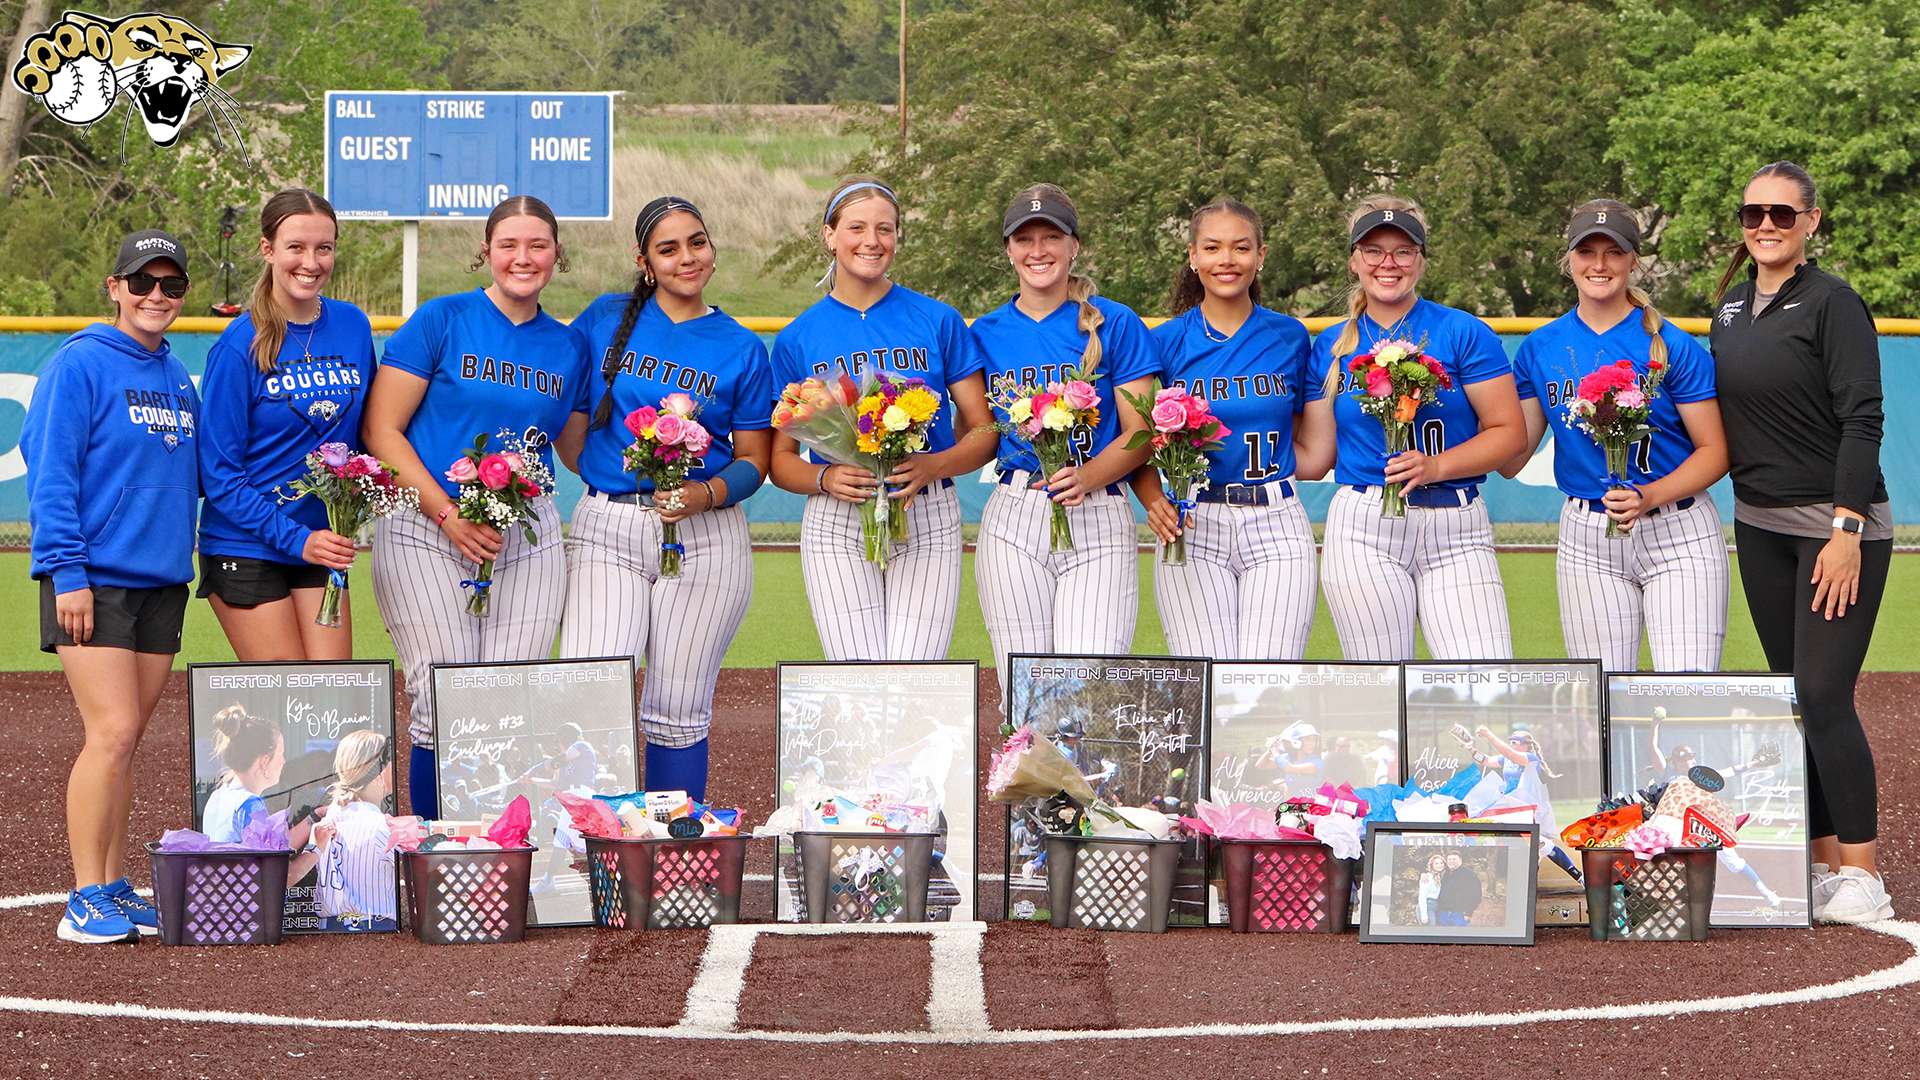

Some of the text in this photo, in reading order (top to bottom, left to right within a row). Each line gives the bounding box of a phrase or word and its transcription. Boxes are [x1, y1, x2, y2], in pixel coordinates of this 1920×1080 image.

[336, 100, 564, 120] BALL STRIKE OUT
[340, 136, 591, 161] GUEST HOME
[429, 184, 509, 208] INNING
[1030, 200, 1042, 212] B
[1383, 210, 1394, 222] B
[1595, 212, 1607, 224] B
[135, 237, 176, 250] BARTON
[285, 361, 342, 374] BARTON
[266, 369, 361, 394] COUGARS
[461, 354, 564, 401] BARTON
[294, 388, 349, 400] SOFTBALL
[209, 672, 382, 689] BARTON SOFTBALL
[451, 668, 622, 689] BARTON SOFTBALL
[1029, 665, 1200, 682] BARTON SOFTBALL
[1221, 671, 1392, 686] BARTON SOFTBALL
[1421, 671, 1591, 685] BARTON SOFTBALL
[1627, 682, 1796, 697] BARTON SOFTBALL
[1112, 703, 1157, 731] Elina
[449, 716, 492, 739] Chloe
[1138, 730, 1193, 763] Bartlett
[1414, 746, 1460, 771] Alicia
